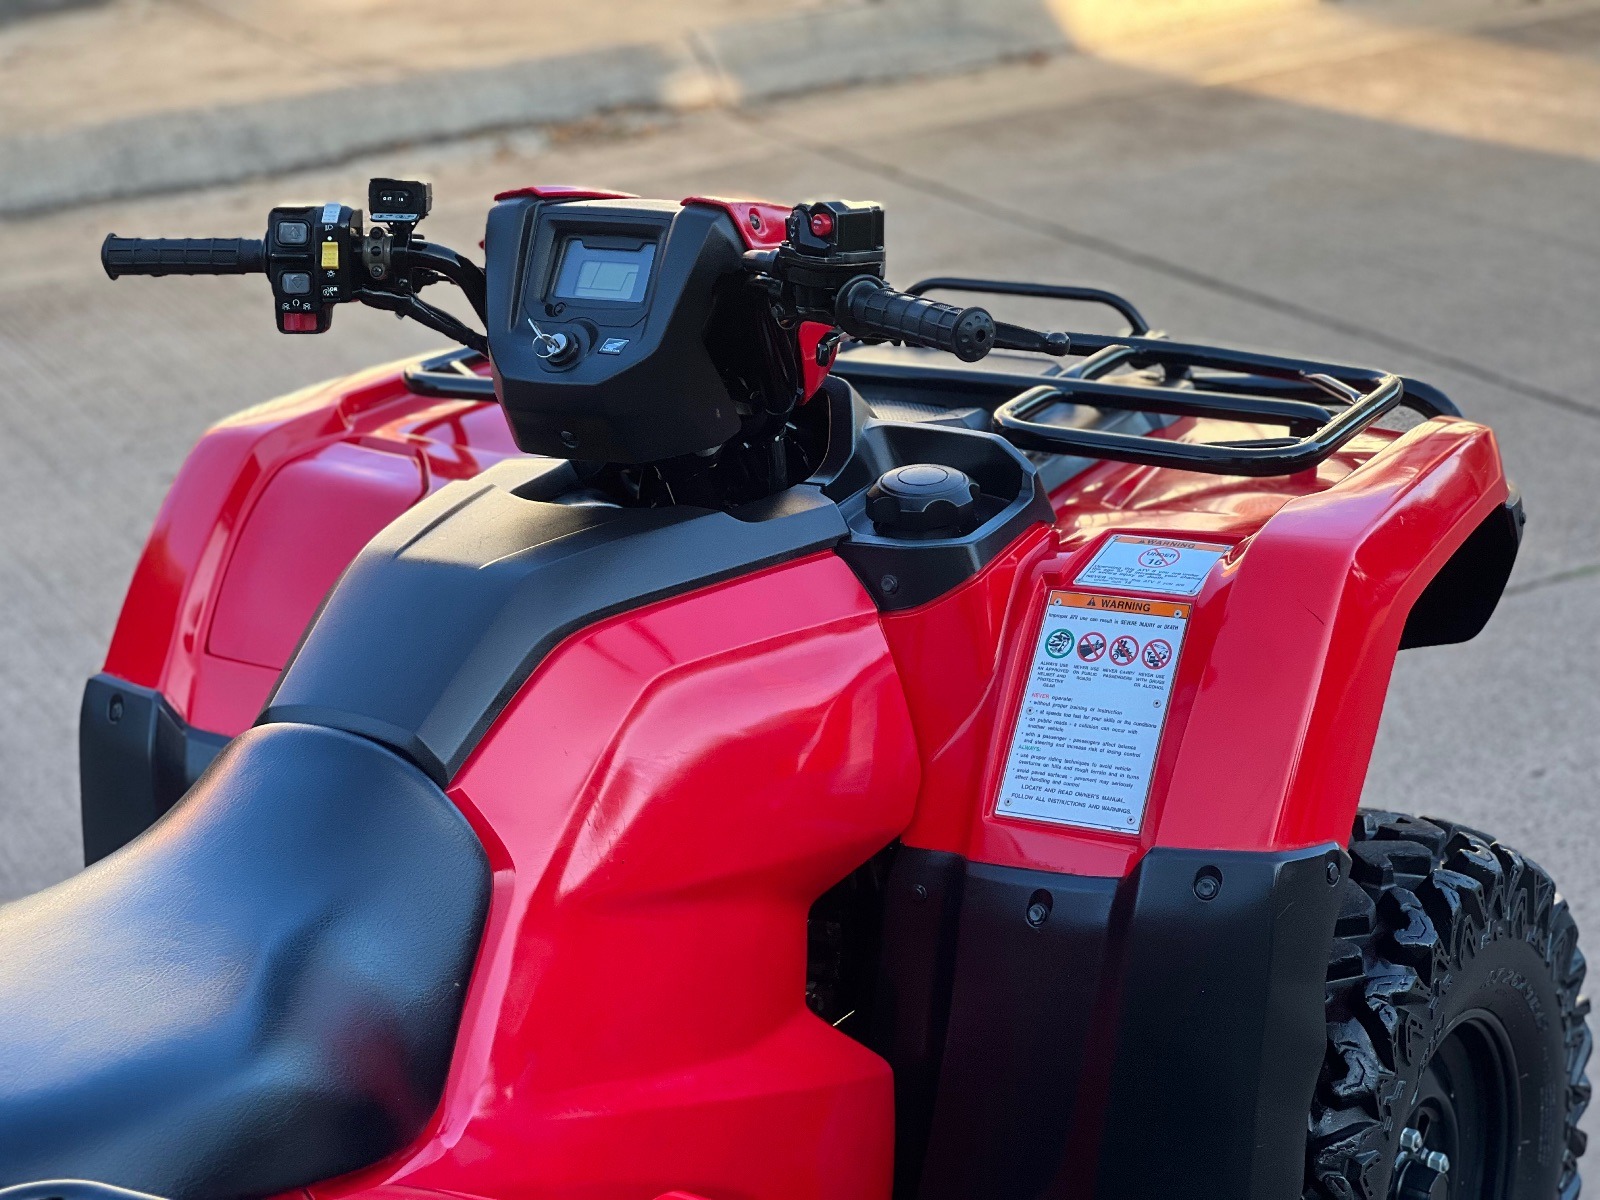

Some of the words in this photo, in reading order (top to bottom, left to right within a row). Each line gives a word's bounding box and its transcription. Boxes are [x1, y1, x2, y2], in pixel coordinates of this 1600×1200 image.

[1146, 539, 1196, 548] WARNING
[1100, 599, 1151, 611] WARNING
[1020, 783, 1042, 791] LOCATE
[1074, 791, 1099, 799] OWNER'S
[1010, 792, 1033, 800] FOLLOW
[1047, 797, 1086, 807] INSTRUCTIONS
